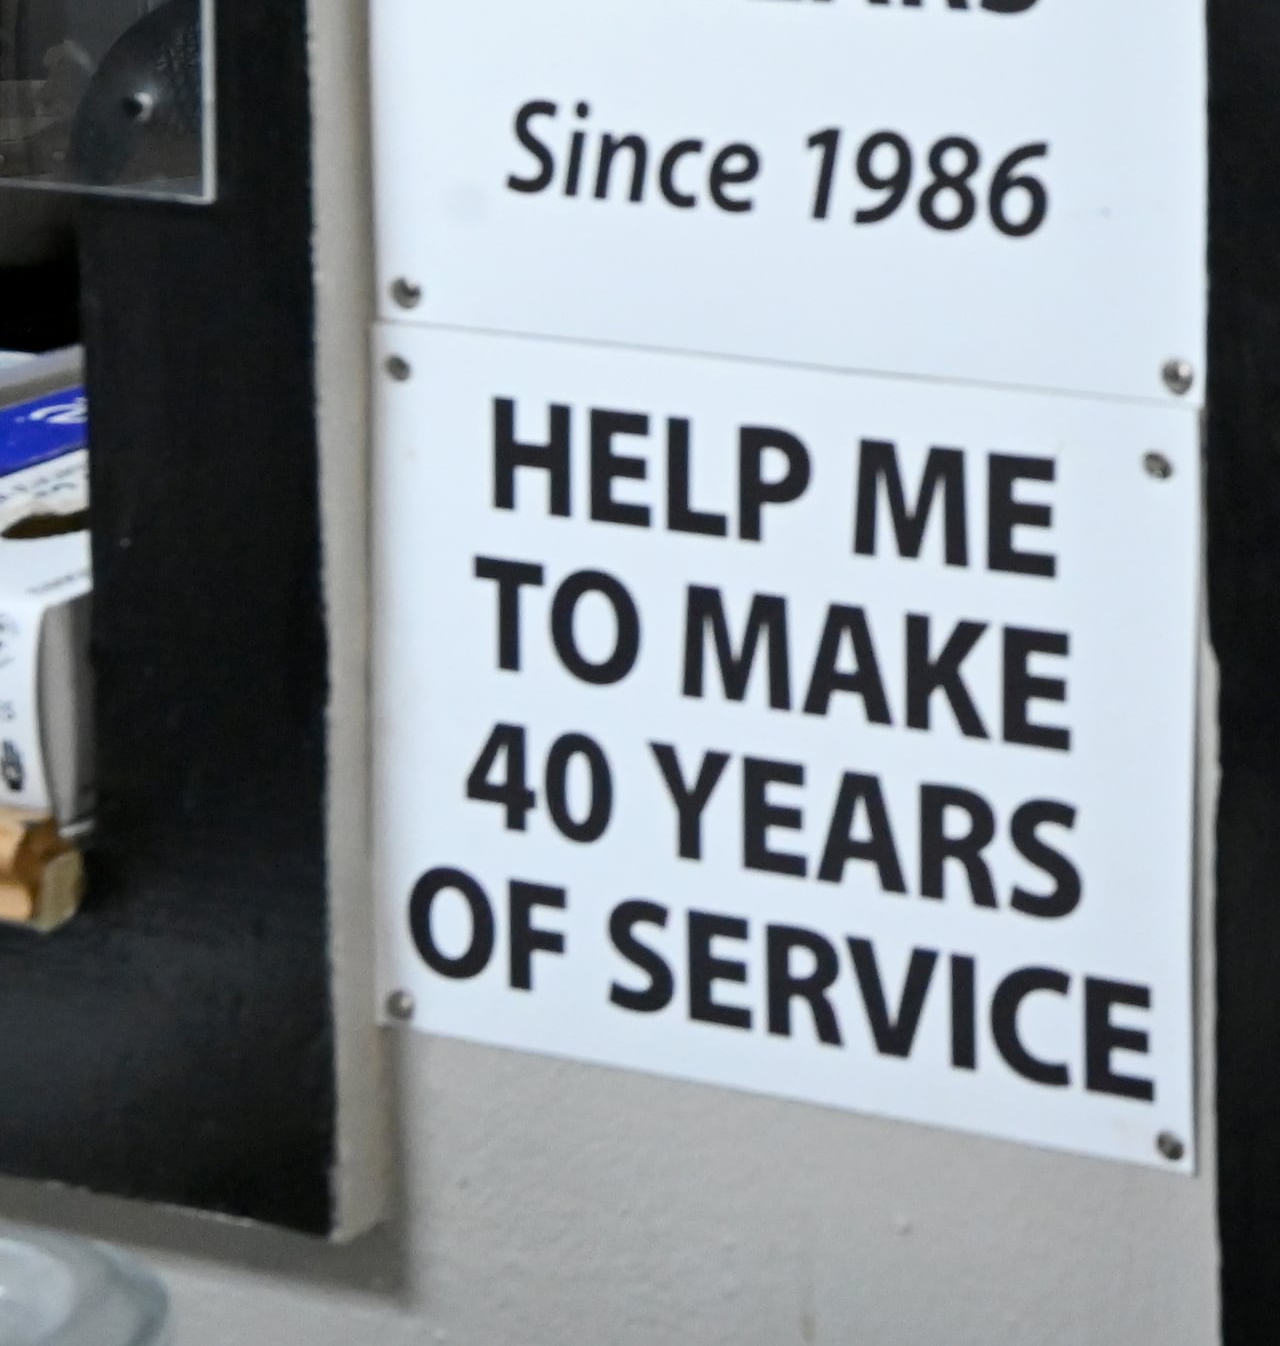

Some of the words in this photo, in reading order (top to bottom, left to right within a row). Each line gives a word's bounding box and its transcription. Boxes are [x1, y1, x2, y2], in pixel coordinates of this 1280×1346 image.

[506, 99, 761, 214] Since
[806, 127, 1049, 239] 1986
[492, 396, 812, 543] HELP
[852, 437, 1057, 579] ME
[473, 554, 642, 687] TO
[681, 583, 1072, 753] MAKE
[465, 721, 614, 845] 40
[648, 740, 1083, 920] YEARS
[406, 865, 568, 993] OF
[607, 898, 1156, 1104] SERVICE
